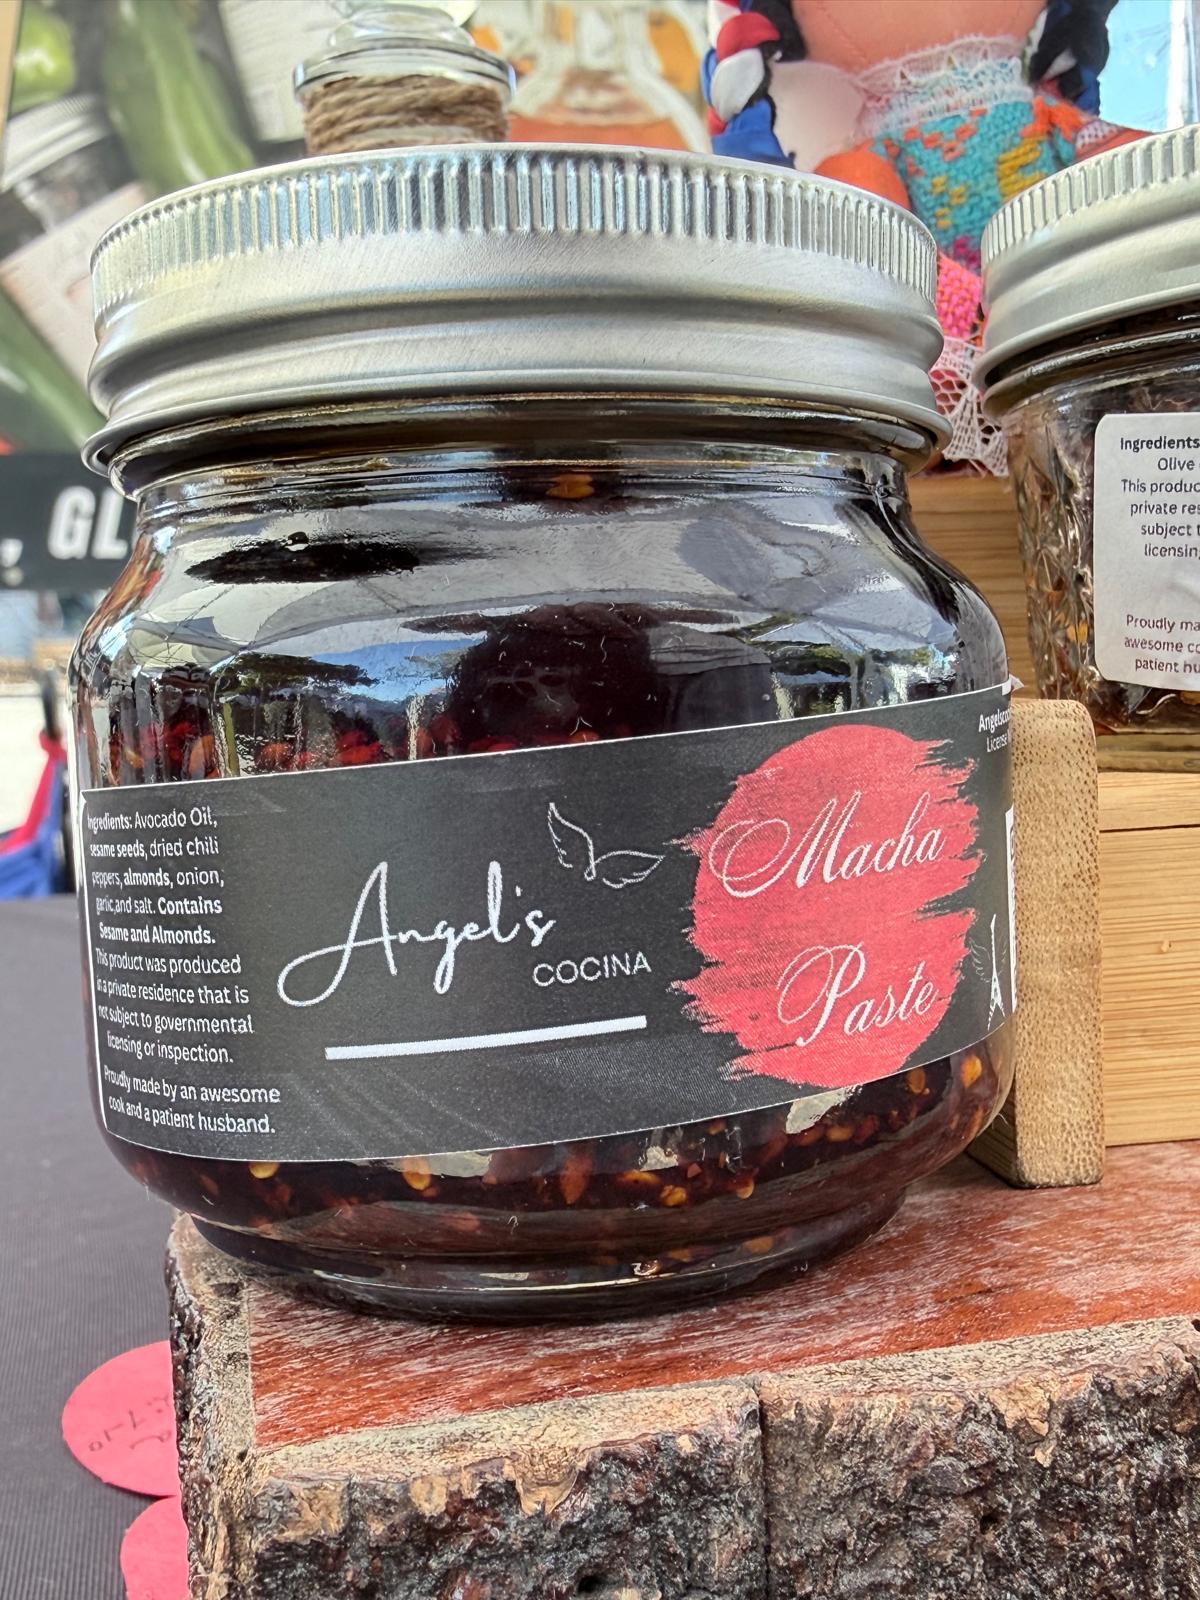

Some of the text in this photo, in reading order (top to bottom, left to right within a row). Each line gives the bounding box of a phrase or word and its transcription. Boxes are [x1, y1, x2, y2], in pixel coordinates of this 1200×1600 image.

[1120, 436, 1200, 453] Ingredients
[1158, 457, 1195, 471] Olive
[1121, 478, 1200, 496] This produc
[1130, 500, 1177, 517] private
[47, 485, 137, 560] GL
[1141, 523, 1192, 539] subject
[1144, 543, 1200, 560] licensin
[1126, 614, 1175, 634] Proudly
[1124, 637, 1183, 653] awesome
[1135, 658, 1179, 673] patient
[87, 806, 218, 834] Ingredients: Avocado Oil,
[90, 836, 219, 860] sesame seeds, dried chili
[708, 789, 947, 898] Macha
[91, 867, 224, 889] peppers, almonds, onion,
[134, 897, 156, 914] salt.
[157, 896, 223, 915] Contains
[99, 922, 216, 944] Sesame and Almonds.
[277, 861, 557, 1007] Angel's
[96, 947, 241, 978] This product was produced
[532, 951, 652, 987] COCINA
[108, 980, 137, 999] private
[138, 984, 195, 1004] residence
[197, 986, 231, 1004] that
[235, 986, 250, 1004] is
[776, 942, 939, 1047] Paste
[98, 1005, 254, 1034] not subject to governmental
[107, 1030, 234, 1064] licensing or inspection.
[104, 1065, 281, 1104] Proudly made by an awesome
[108, 1095, 276, 1134] cook and a patient husband.
